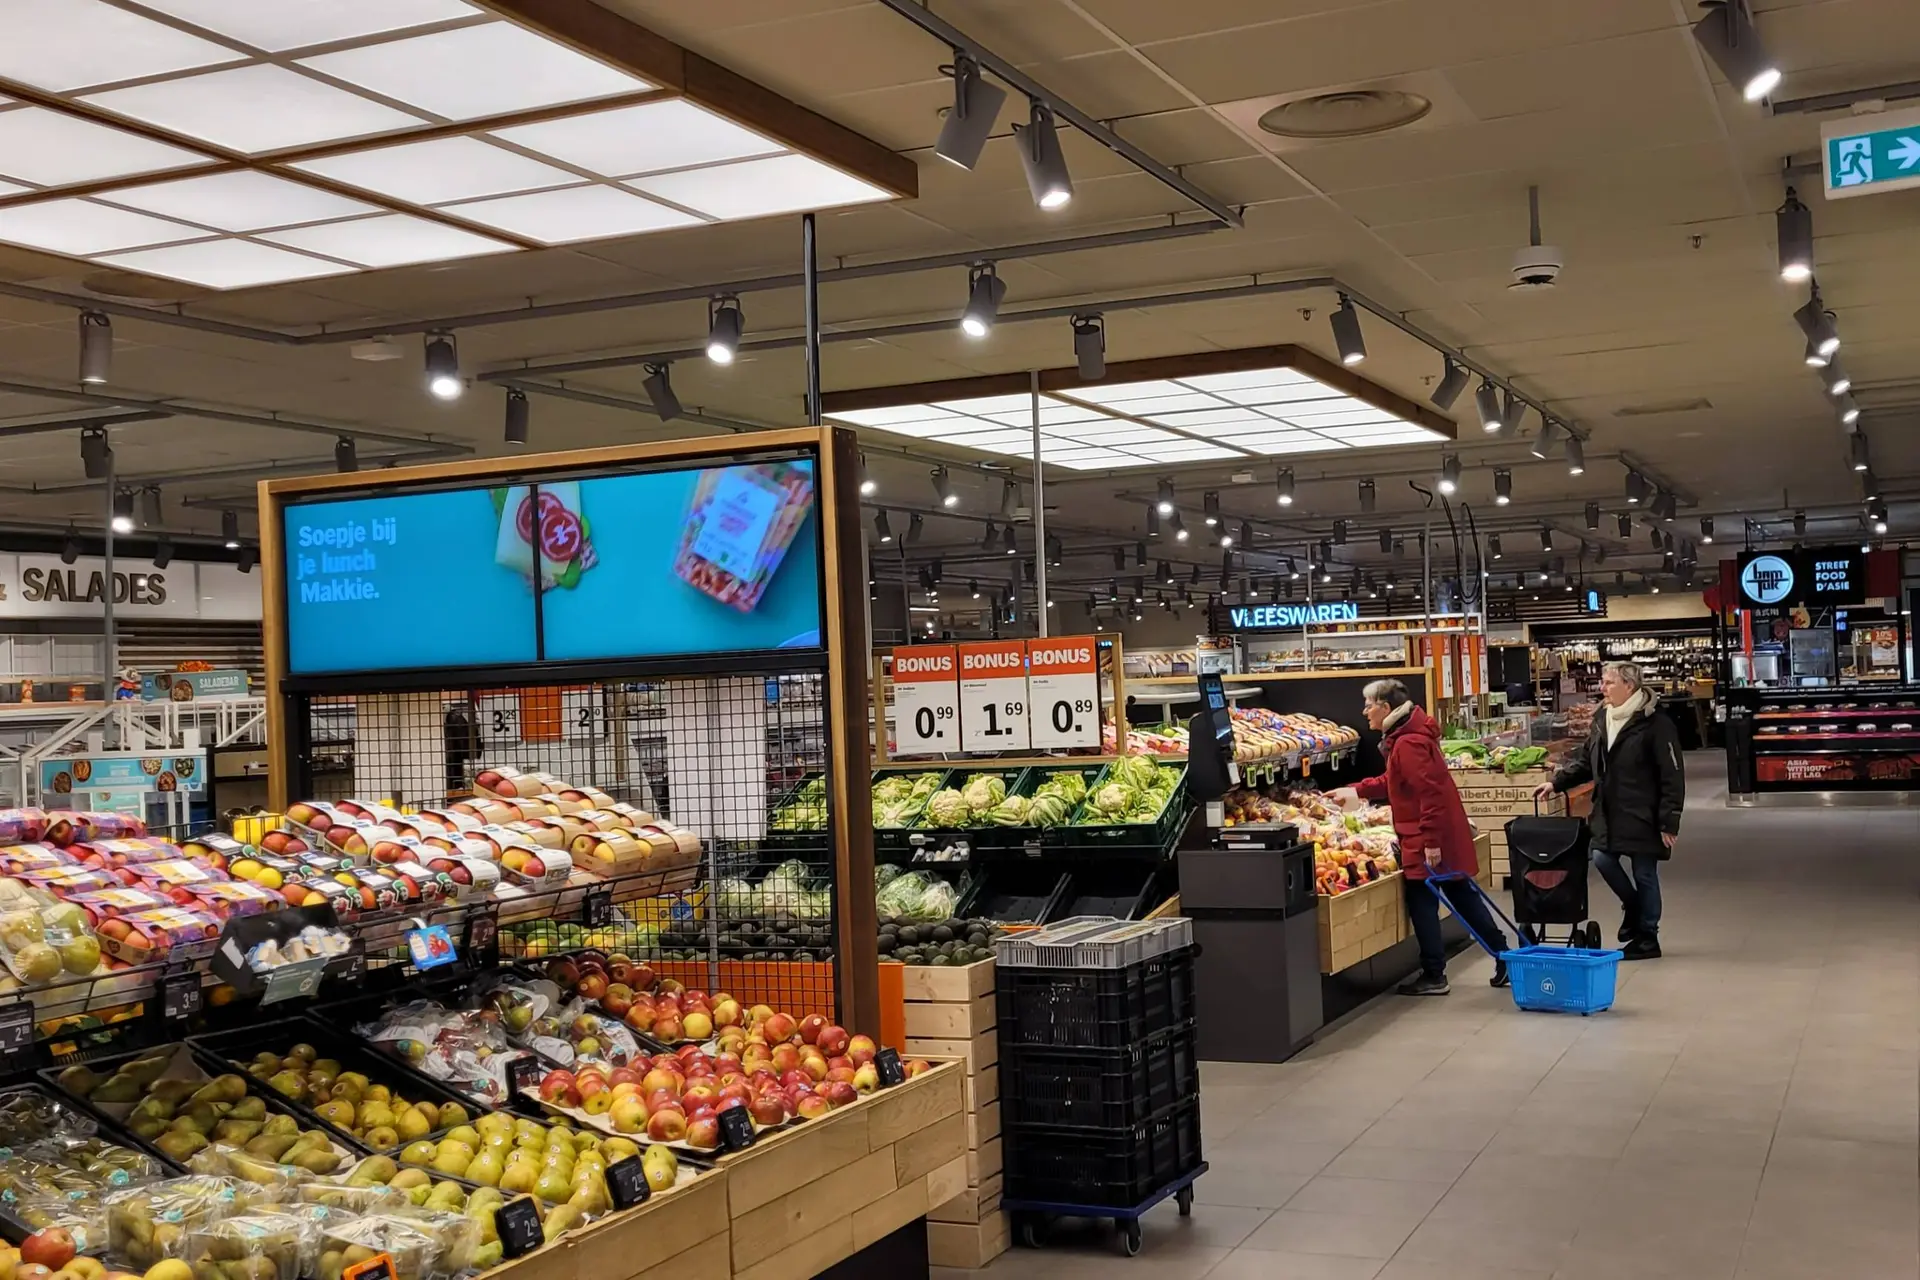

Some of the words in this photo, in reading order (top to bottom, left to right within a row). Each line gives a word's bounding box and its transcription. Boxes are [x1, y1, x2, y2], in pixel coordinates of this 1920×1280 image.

[298, 520, 366, 549] Soepje
[371, 517, 397, 546] bij
[296, 553, 317, 580] je
[321, 548, 377, 574] lunch
[1815, 560, 1850, 571] STREET
[1816, 571, 1846, 581] FOOD
[22, 567, 167, 606] SALADES
[300, 577, 380, 604] Makkie.
[1816, 581, 1850, 592] D'ASIE
[1231, 602, 1358, 628] VLEESWAREN
[896, 656, 953, 673] BONUS
[963, 652, 1020, 669] BONUS
[1032, 648, 1091, 666] BONUS
[1495, 788, 1527, 799] Heijn
